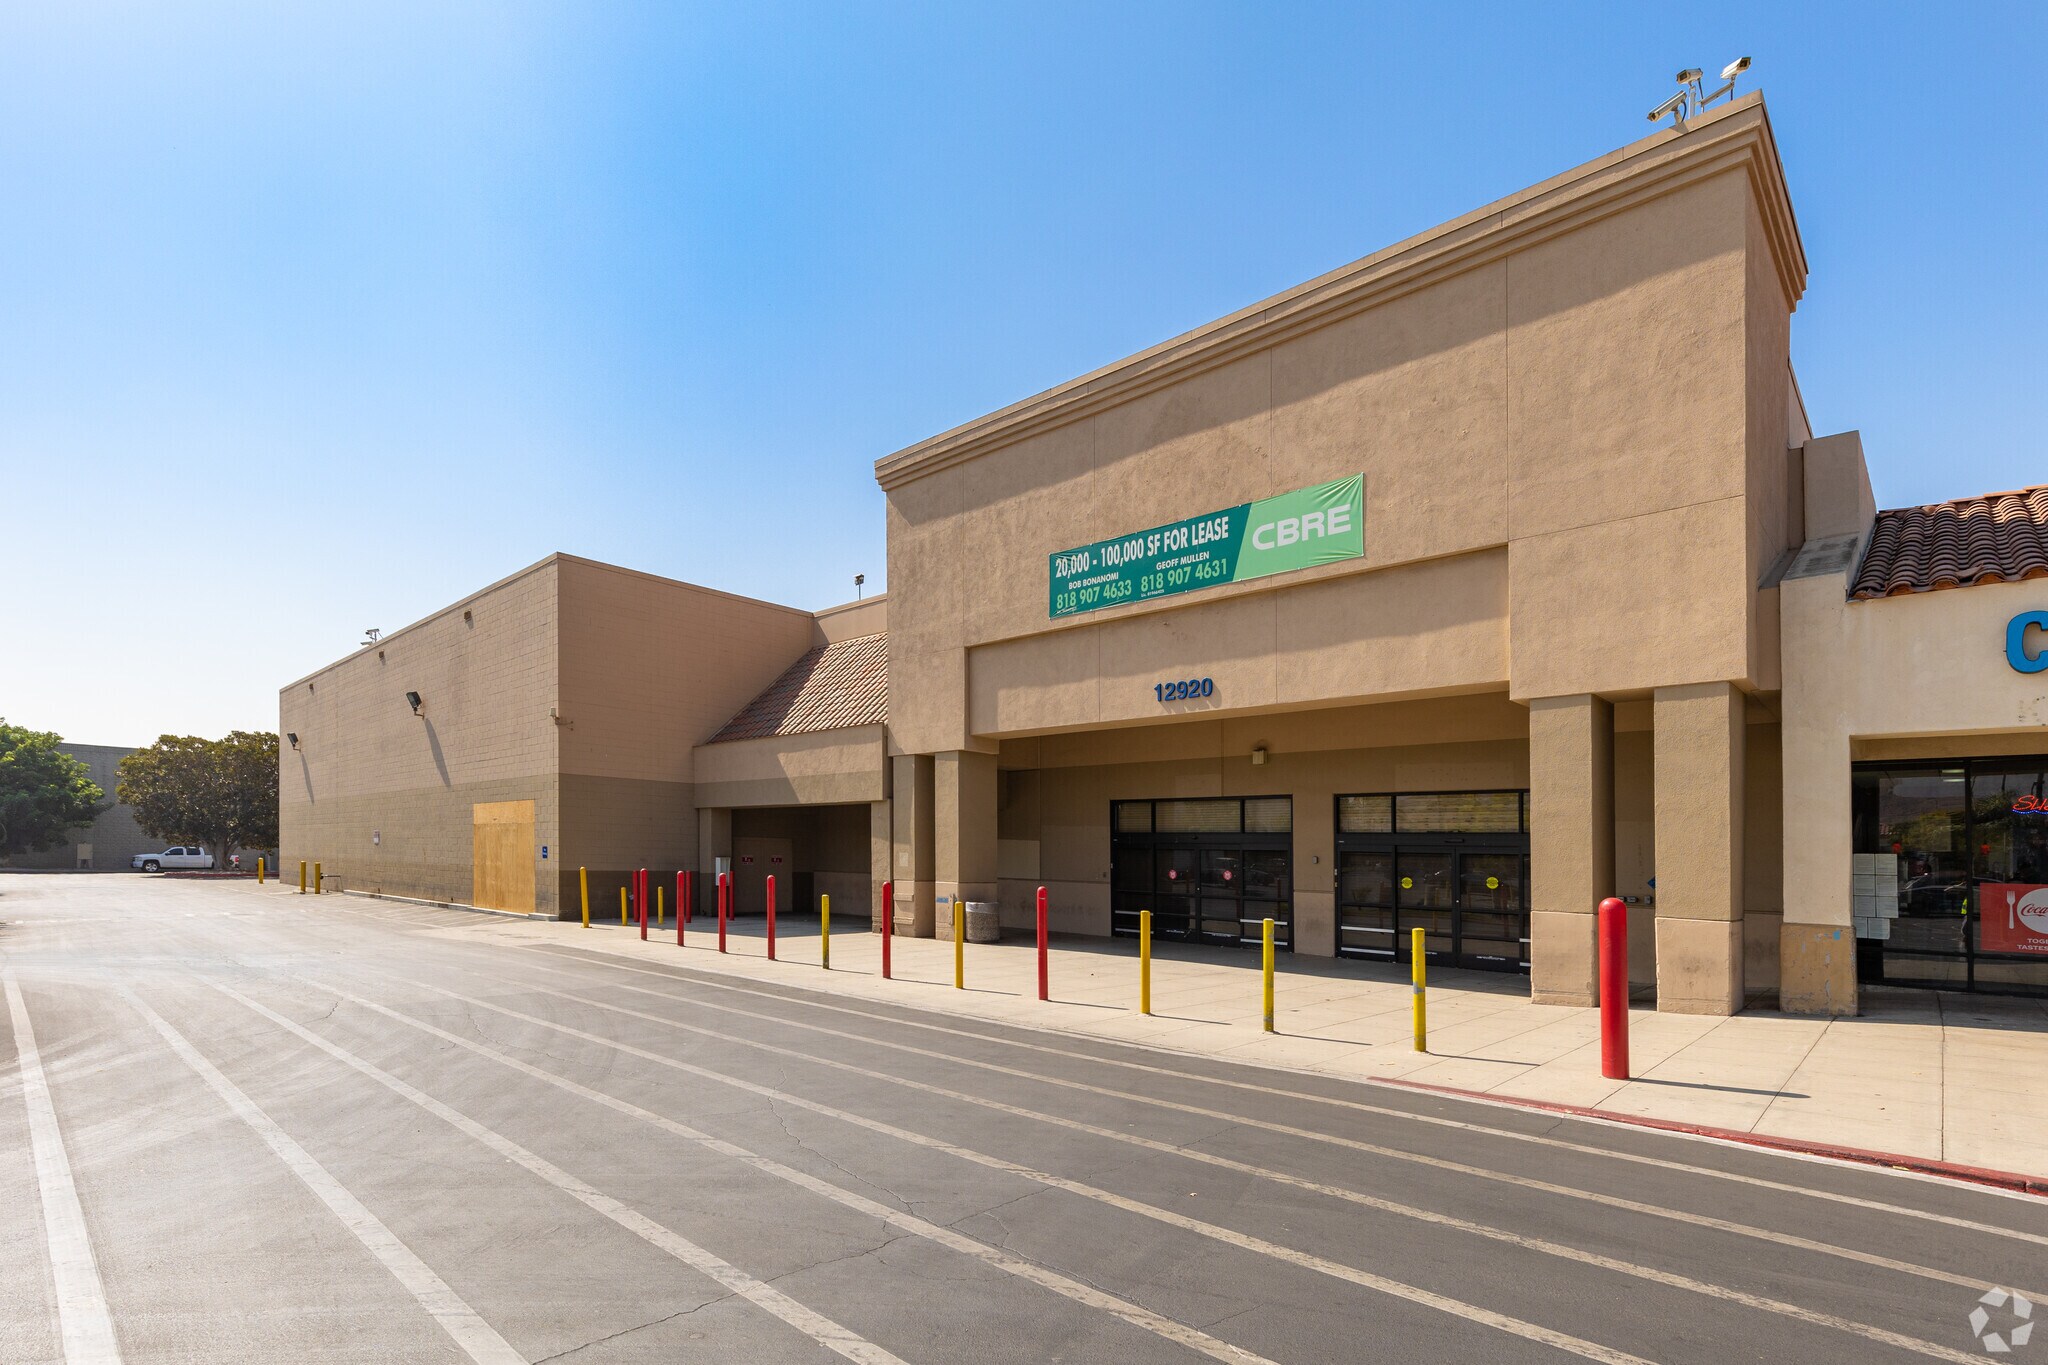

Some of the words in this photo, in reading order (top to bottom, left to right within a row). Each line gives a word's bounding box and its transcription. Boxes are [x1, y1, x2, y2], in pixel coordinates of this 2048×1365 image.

[1252, 503, 1352, 551] CBRE
[1055, 551, 1090, 579] 20,000
[1100, 538, 1144, 568] 100,000
[1147, 533, 1161, 557] SF
[1163, 527, 1188, 553] FOR
[1191, 516, 1229, 546] LEASE
[1156, 558, 1179, 571] GEOFF
[1180, 551, 1210, 566] MULLEN
[1068, 580, 1082, 590] BOB
[1082, 571, 1119, 587] BONANOMI
[1140, 572, 1164, 592] 818
[1167, 566, 1192, 587] 907
[1194, 558, 1227, 580] 4631
[1056, 591, 1077, 609] 818
[1079, 586, 1100, 605] 907
[1103, 579, 1132, 599] 4633
[1153, 677, 1214, 702] 12920
